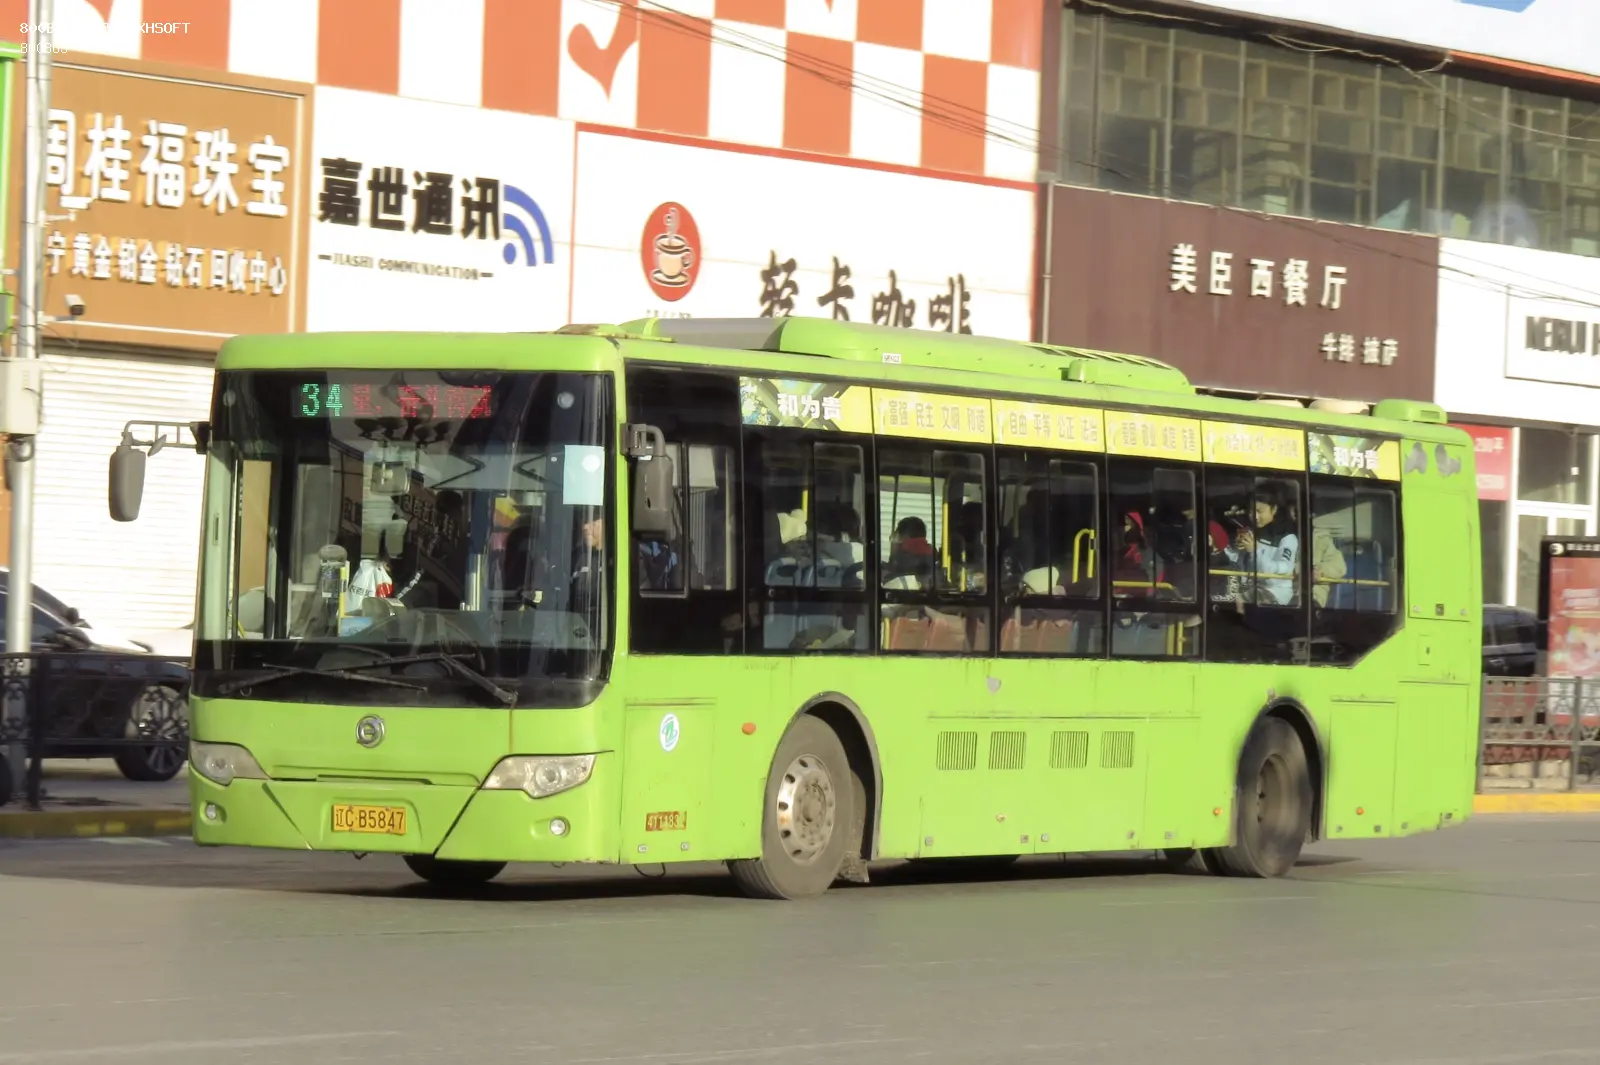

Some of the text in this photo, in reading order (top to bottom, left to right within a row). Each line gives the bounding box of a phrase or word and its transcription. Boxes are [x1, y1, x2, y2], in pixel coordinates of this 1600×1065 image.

[46, 109, 290, 216] 周桂福珠宝
[318, 158, 500, 240] 嘉世通讯
[333, 253, 479, 281] JIASHI COMMUNICATION
[1170, 243, 1347, 309] 美臣西餐厅
[302, 383, 343, 417] 34
[777, 393, 841, 420] 和为贵
